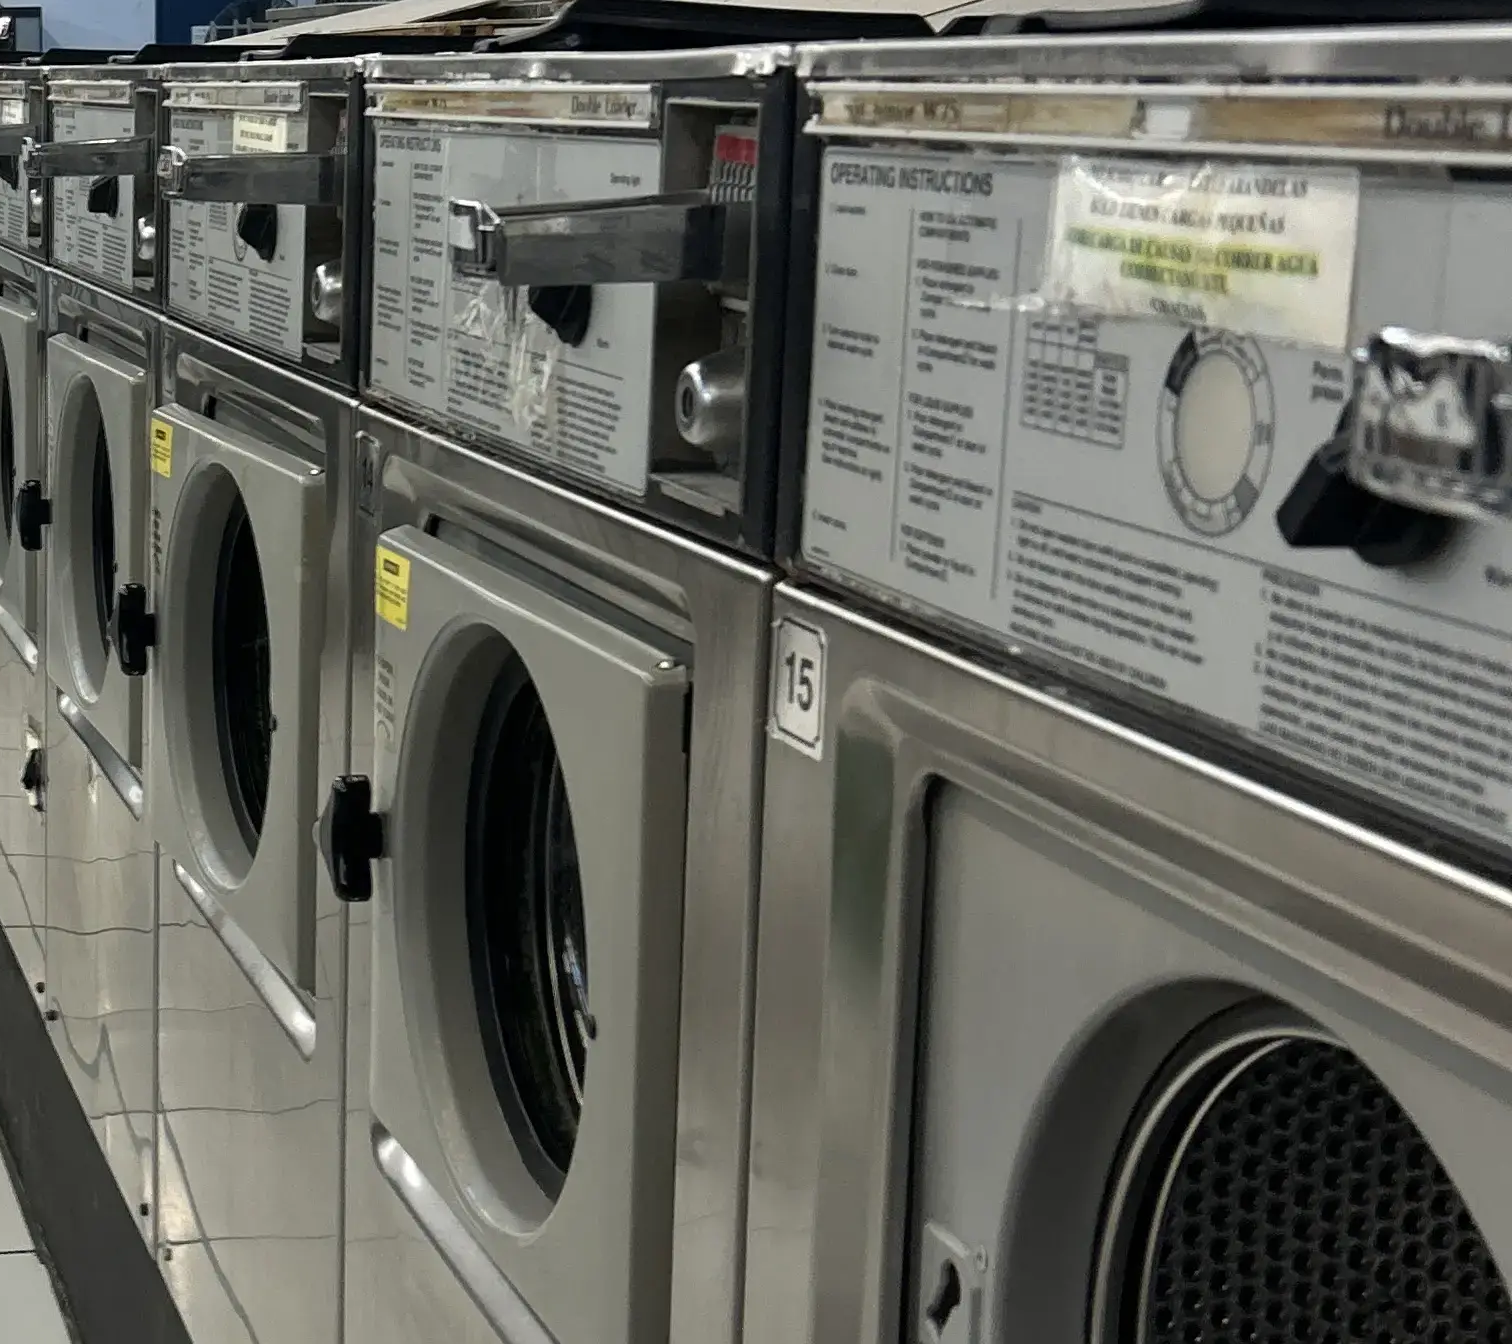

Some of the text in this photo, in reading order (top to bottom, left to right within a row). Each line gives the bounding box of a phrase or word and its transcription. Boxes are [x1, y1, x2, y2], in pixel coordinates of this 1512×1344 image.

[831, 162, 993, 196] OPERATING INSTRUCTIONS
[786, 651, 814, 712] 15
